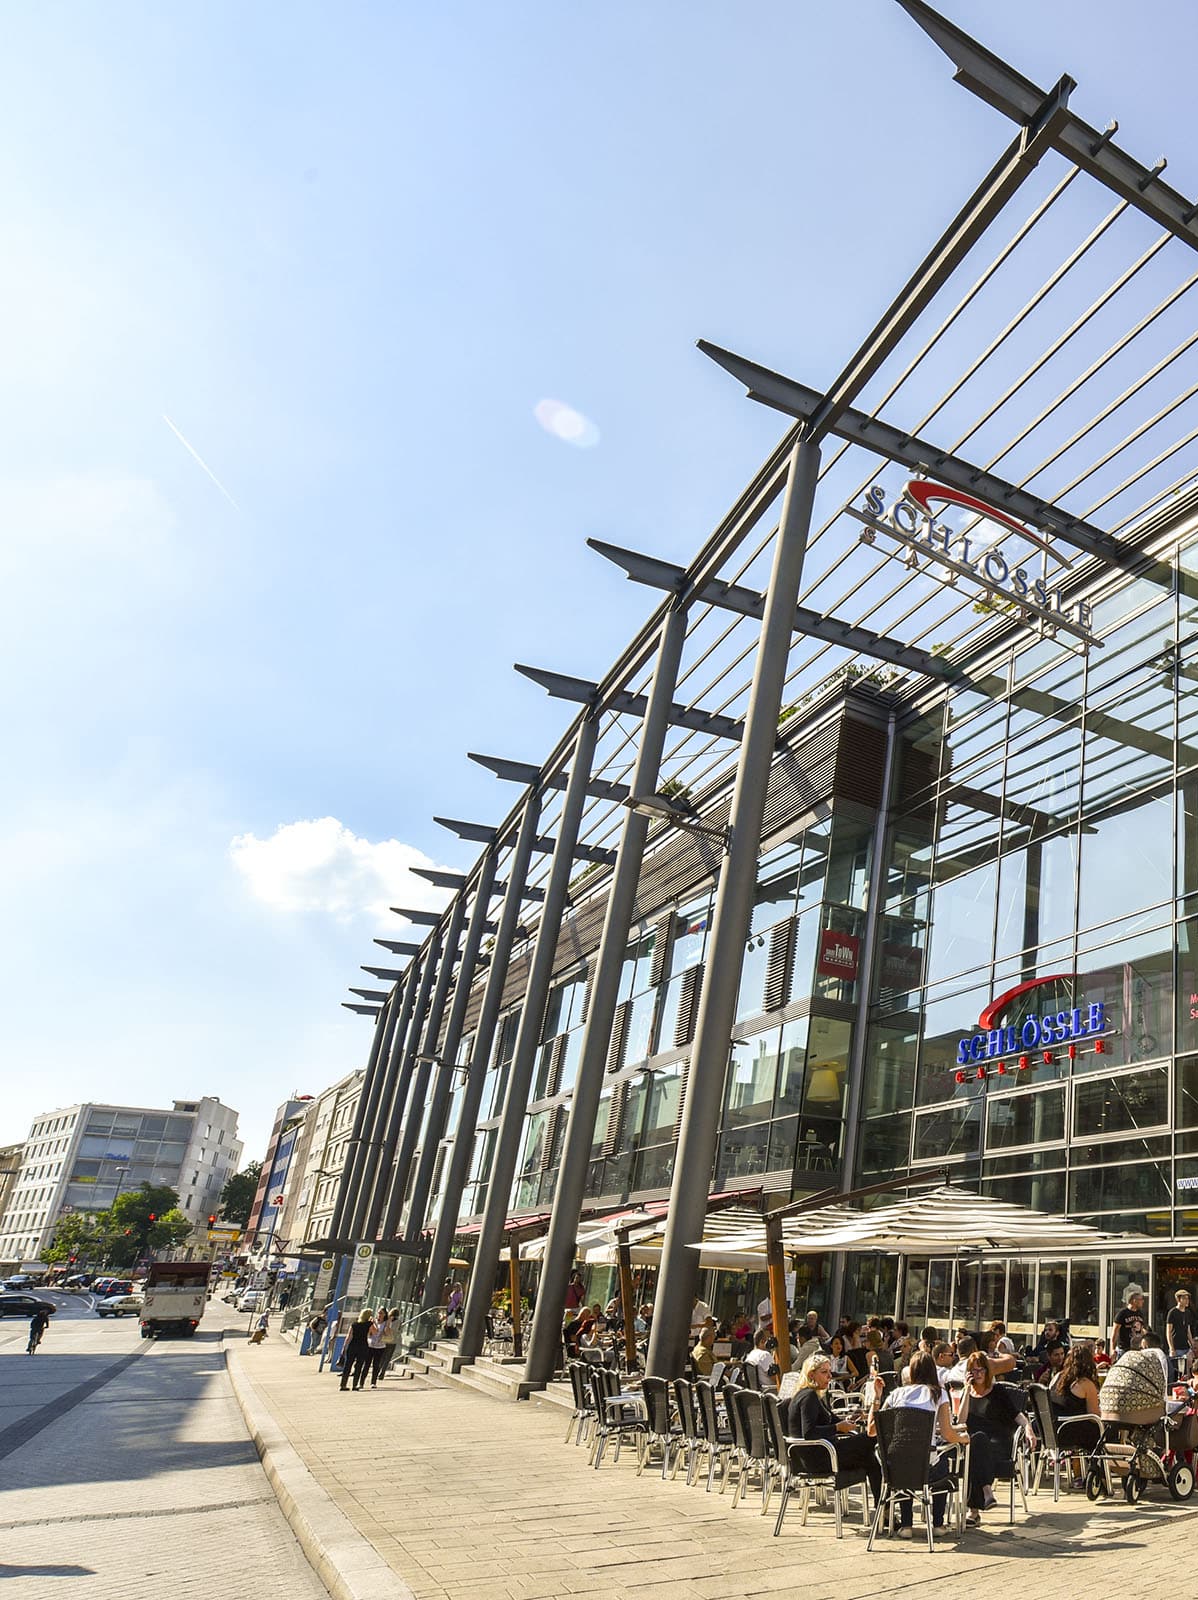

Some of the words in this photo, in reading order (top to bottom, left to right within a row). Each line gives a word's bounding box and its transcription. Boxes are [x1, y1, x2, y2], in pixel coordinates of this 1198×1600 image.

[863, 485, 1092, 632] SCHLÖSSLE
[955, 1039, 1105, 1083] GALERIE
[957, 1002, 1105, 1064] SCHLÖSSLE
